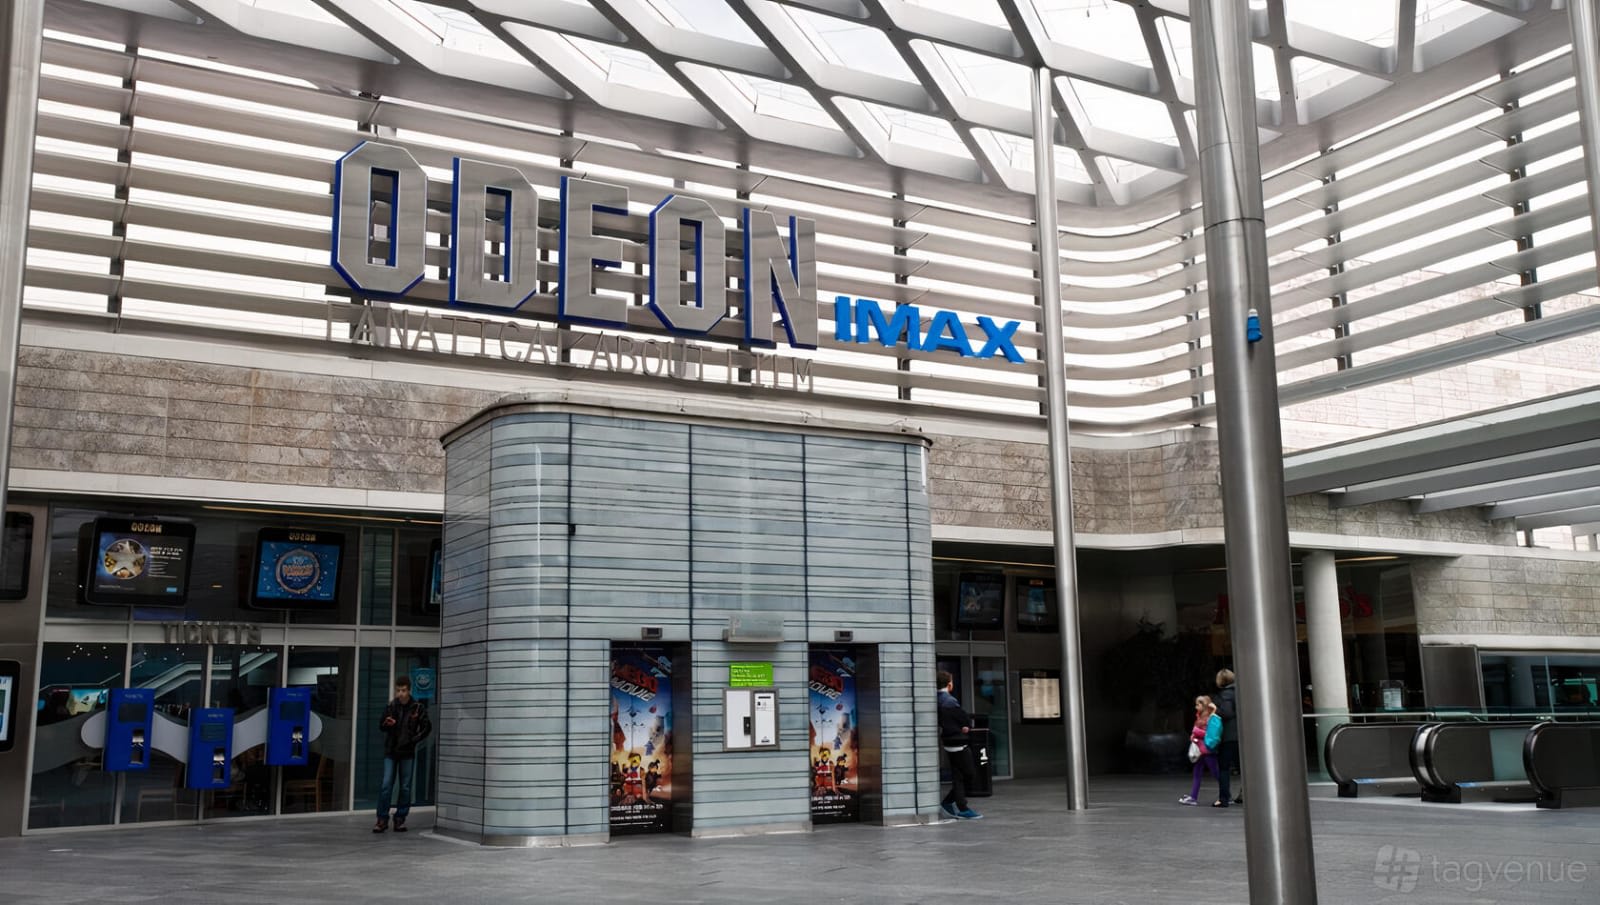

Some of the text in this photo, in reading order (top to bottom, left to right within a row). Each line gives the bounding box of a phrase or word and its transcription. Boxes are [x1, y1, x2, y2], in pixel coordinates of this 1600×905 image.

[331, 140, 819, 350] ODEON
[590, 330, 713, 382] ABOUT
[834, 295, 1026, 365] IMAX
[161, 620, 263, 646] TICKETS
